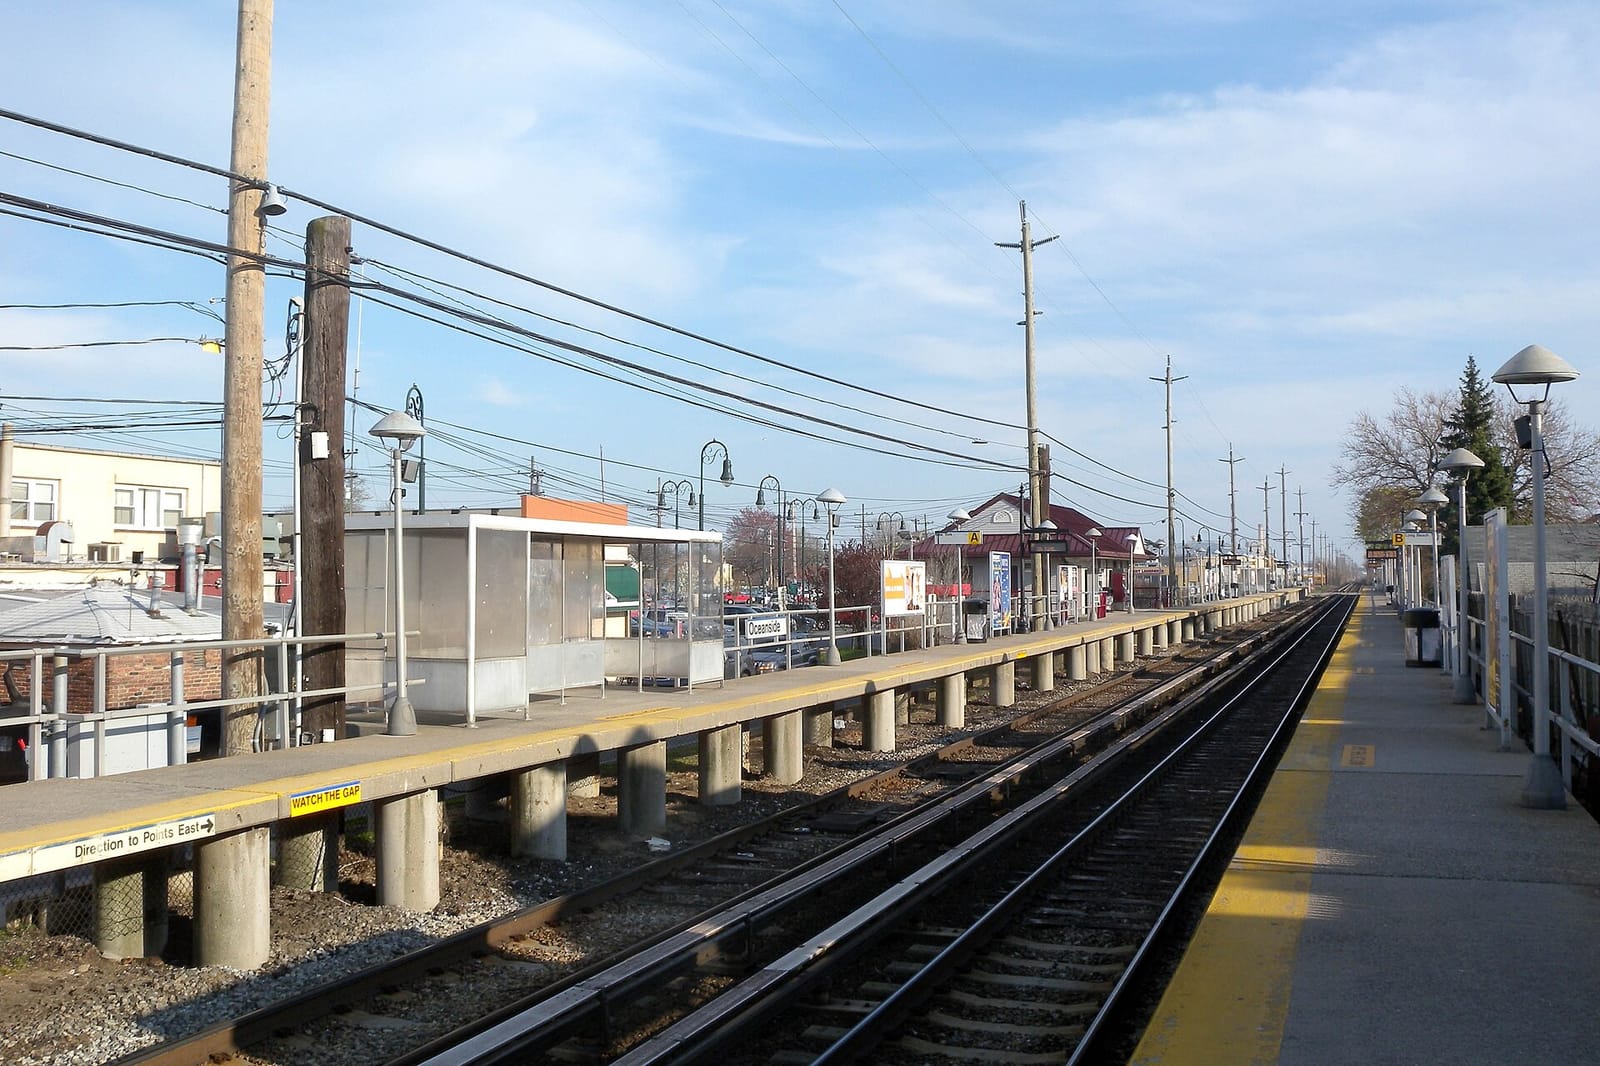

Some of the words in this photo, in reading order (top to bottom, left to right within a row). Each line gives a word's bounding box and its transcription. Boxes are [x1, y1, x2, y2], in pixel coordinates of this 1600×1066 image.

[970, 532, 979, 542] A
[1395, 533, 1403, 543] B
[748, 620, 781, 635] Oceanside
[292, 793, 323, 809] WATCH
[324, 789, 341, 801] THE
[343, 785, 360, 798] GAP
[75, 839, 123, 858] Direction
[128, 836, 139, 846] to
[143, 828, 174, 843] Points
[178, 822, 200, 836] East
